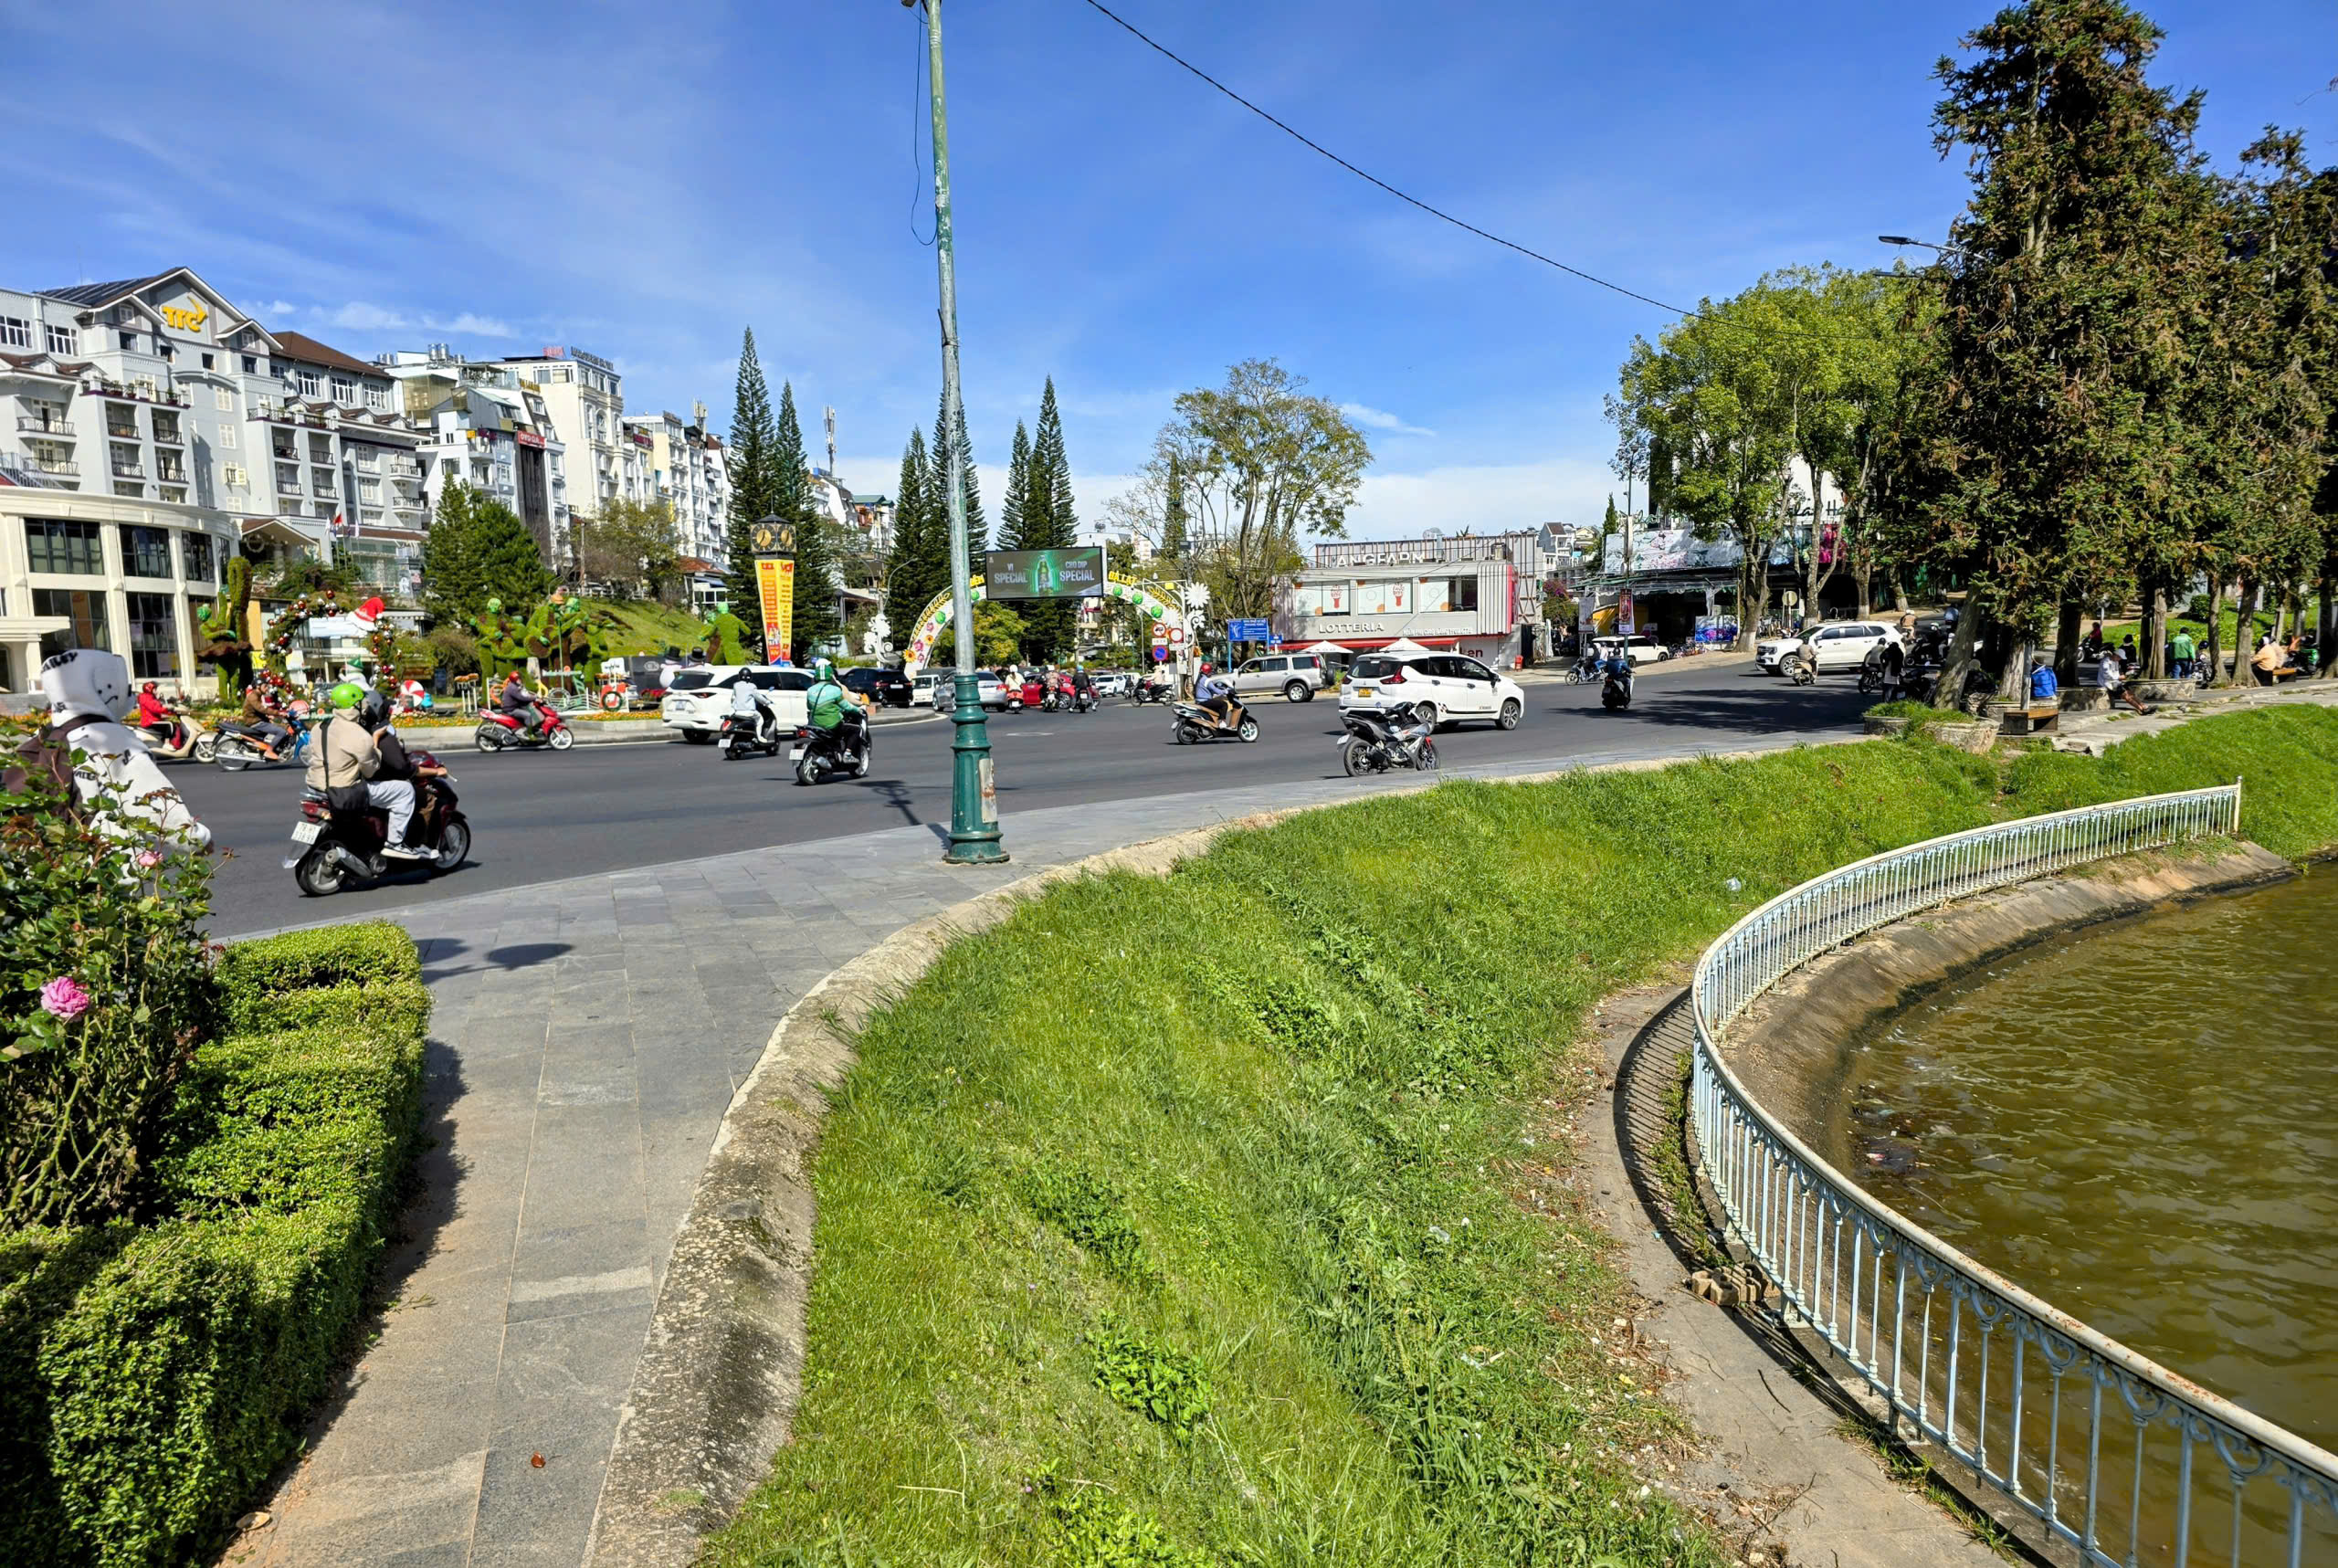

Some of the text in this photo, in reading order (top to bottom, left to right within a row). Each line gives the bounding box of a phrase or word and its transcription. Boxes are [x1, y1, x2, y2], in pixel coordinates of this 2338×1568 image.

[995, 573, 1027, 584] SPECIAL
[1059, 569, 1095, 582] SPECIAL
[1319, 622, 1385, 634] LOTTERIA
